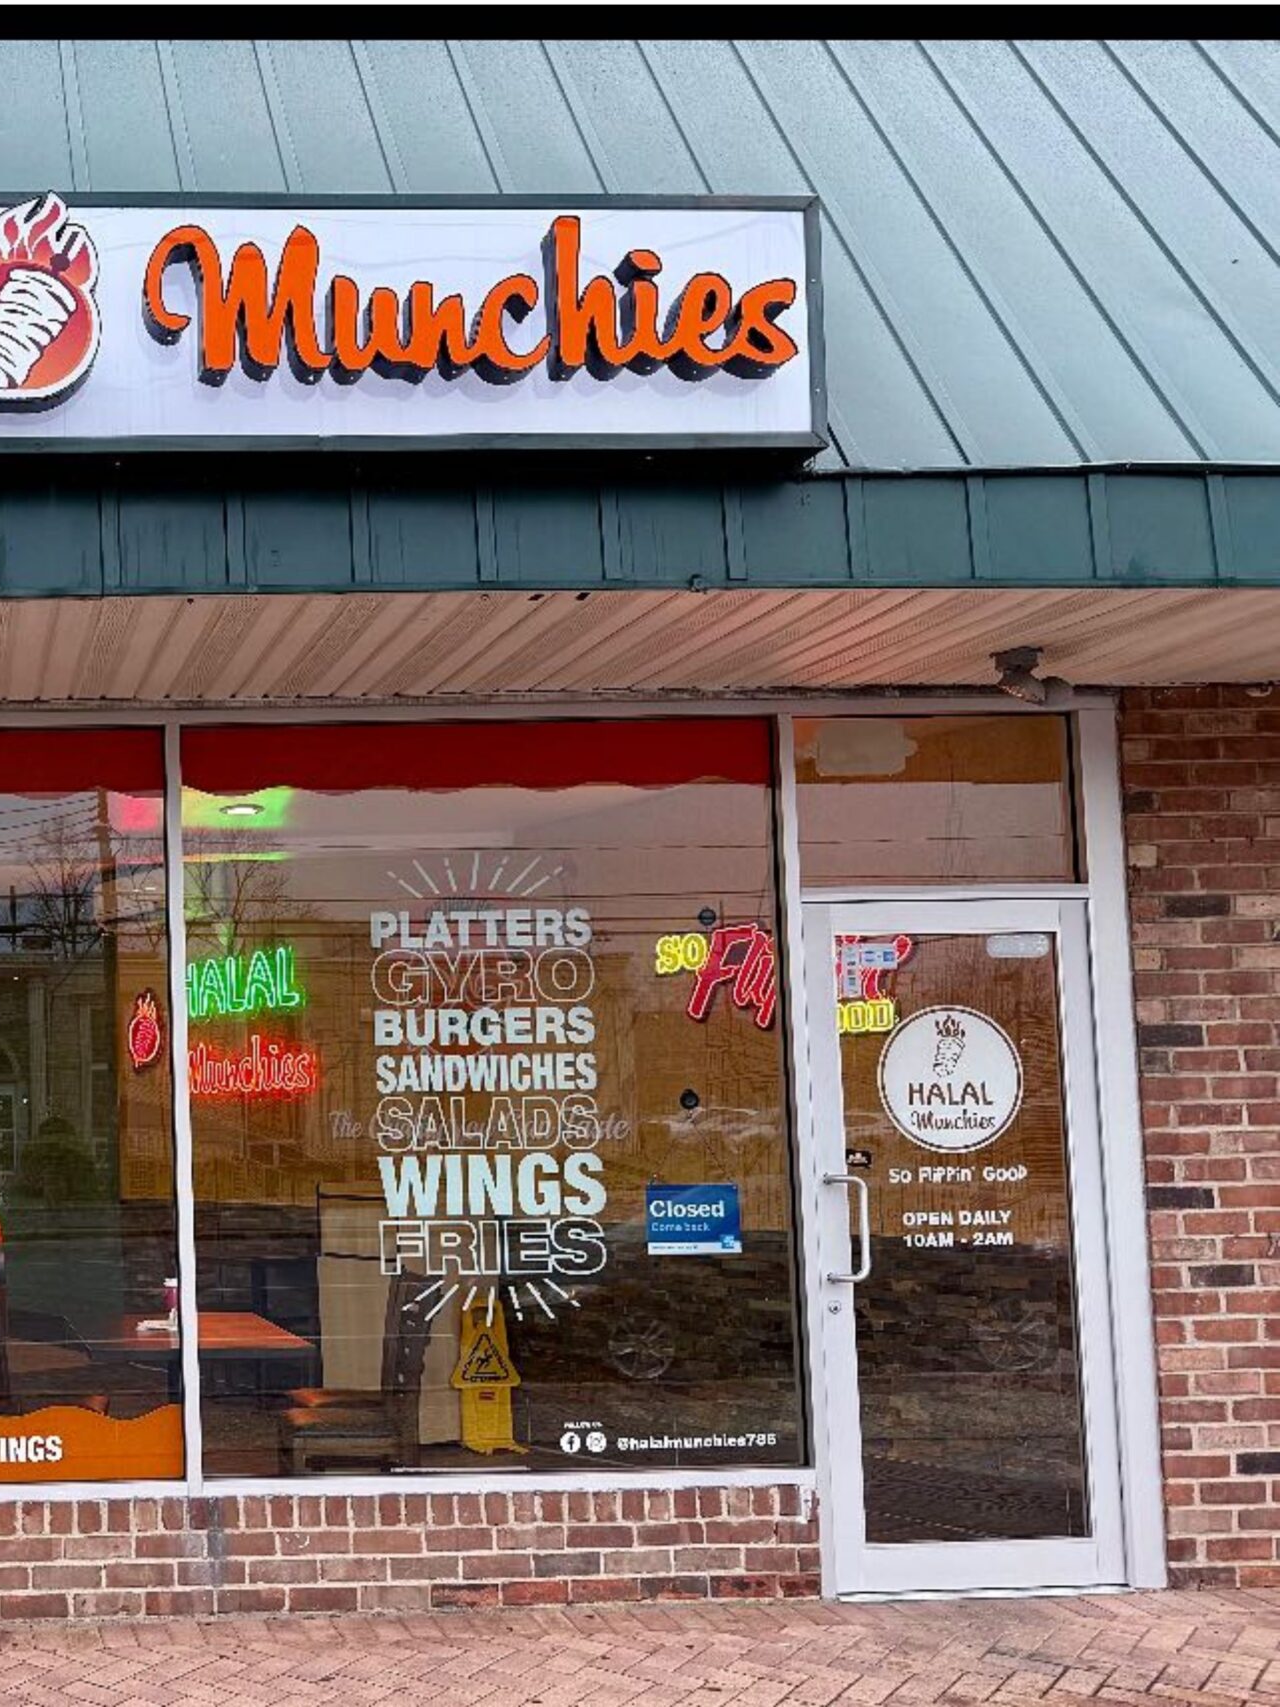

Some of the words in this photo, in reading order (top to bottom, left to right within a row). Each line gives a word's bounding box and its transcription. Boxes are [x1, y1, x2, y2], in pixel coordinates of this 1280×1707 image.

[143, 215, 800, 387] Munchies
[371, 908, 593, 949] PLATTERS
[656, 933, 708, 974] SO
[372, 947, 595, 1005] GYRO
[374, 1006, 596, 1046] BURGERS
[376, 1052, 598, 1093] SANDWICHES
[908, 1081, 994, 1106] HALAL
[376, 1094, 600, 1152] SALADS
[910, 1108, 996, 1131] Munchies
[377, 1152, 607, 1217] WINGS
[649, 1199, 725, 1218] Closed
[902, 1211, 954, 1226] OPEN
[959, 1210, 1012, 1225] DAILY
[379, 1217, 607, 1276] FRIES
[903, 1232, 954, 1247] 10AM
[972, 1232, 1013, 1245] 2AM
